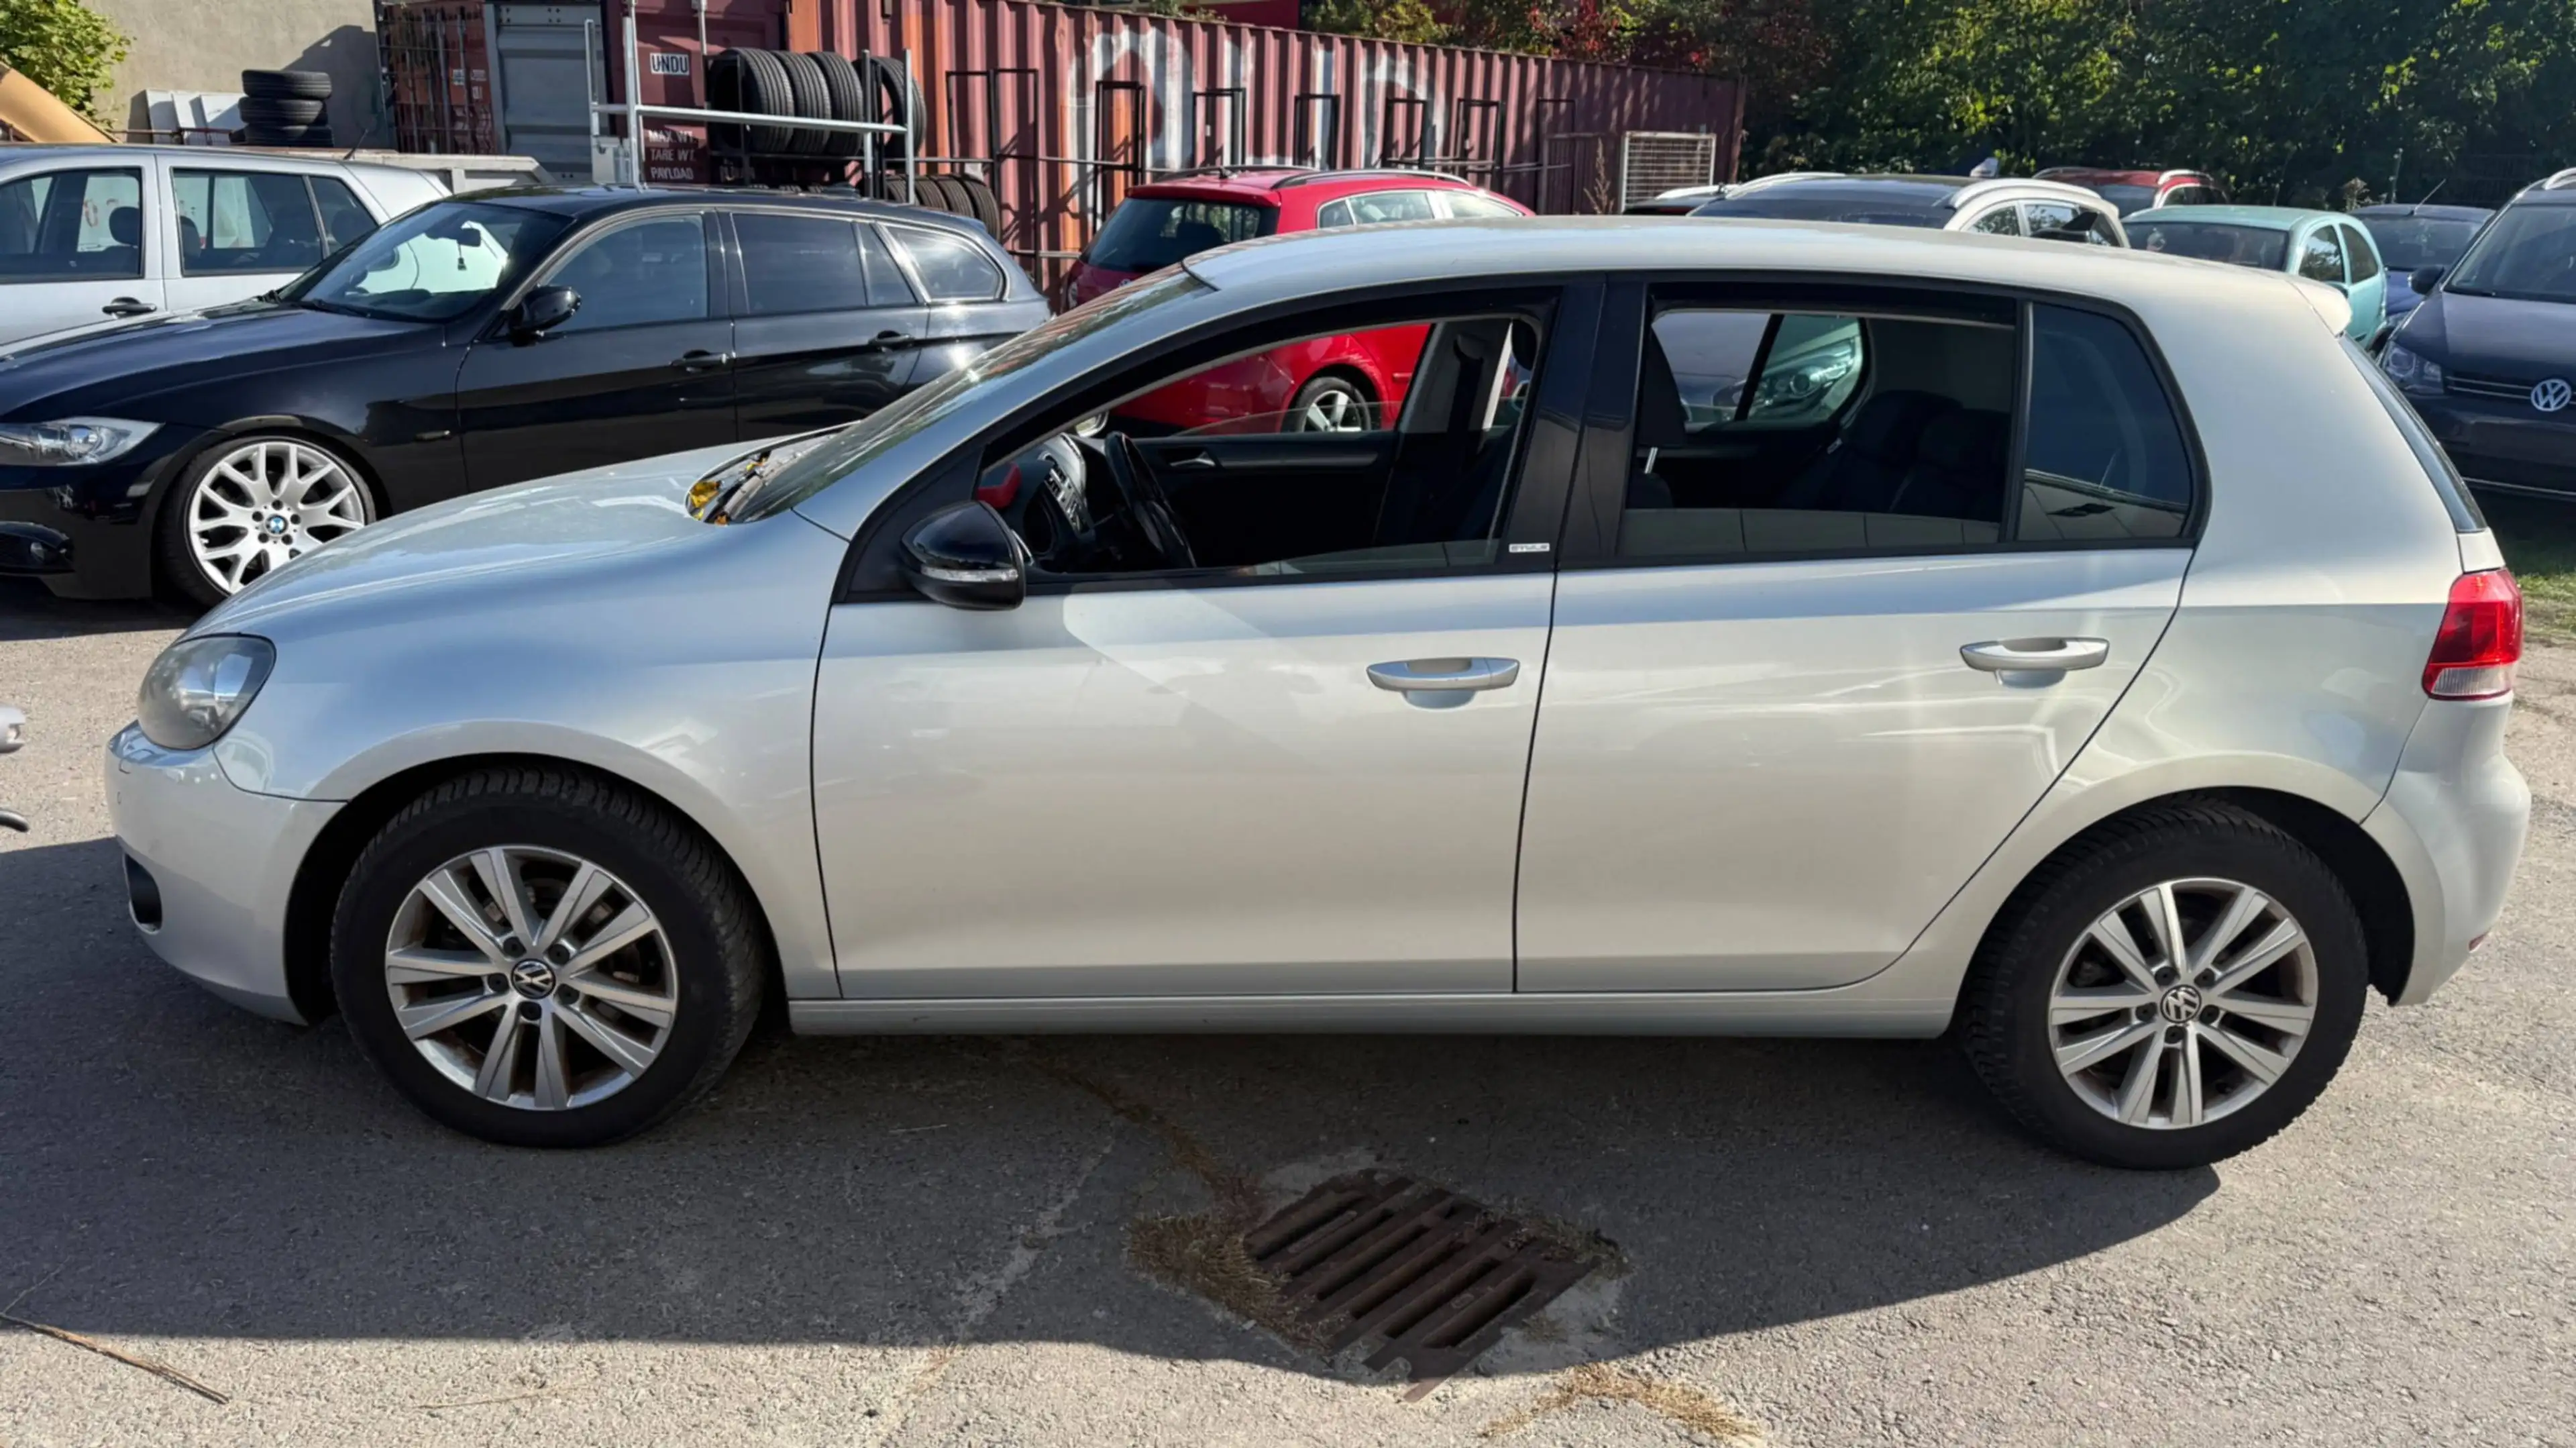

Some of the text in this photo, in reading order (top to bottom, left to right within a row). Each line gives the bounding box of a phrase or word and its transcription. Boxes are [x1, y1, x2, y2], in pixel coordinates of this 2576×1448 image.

[651, 55, 689, 73] UNDU
[650, 148, 674, 161] TARE
[650, 166, 694, 180] PAYLOAD
